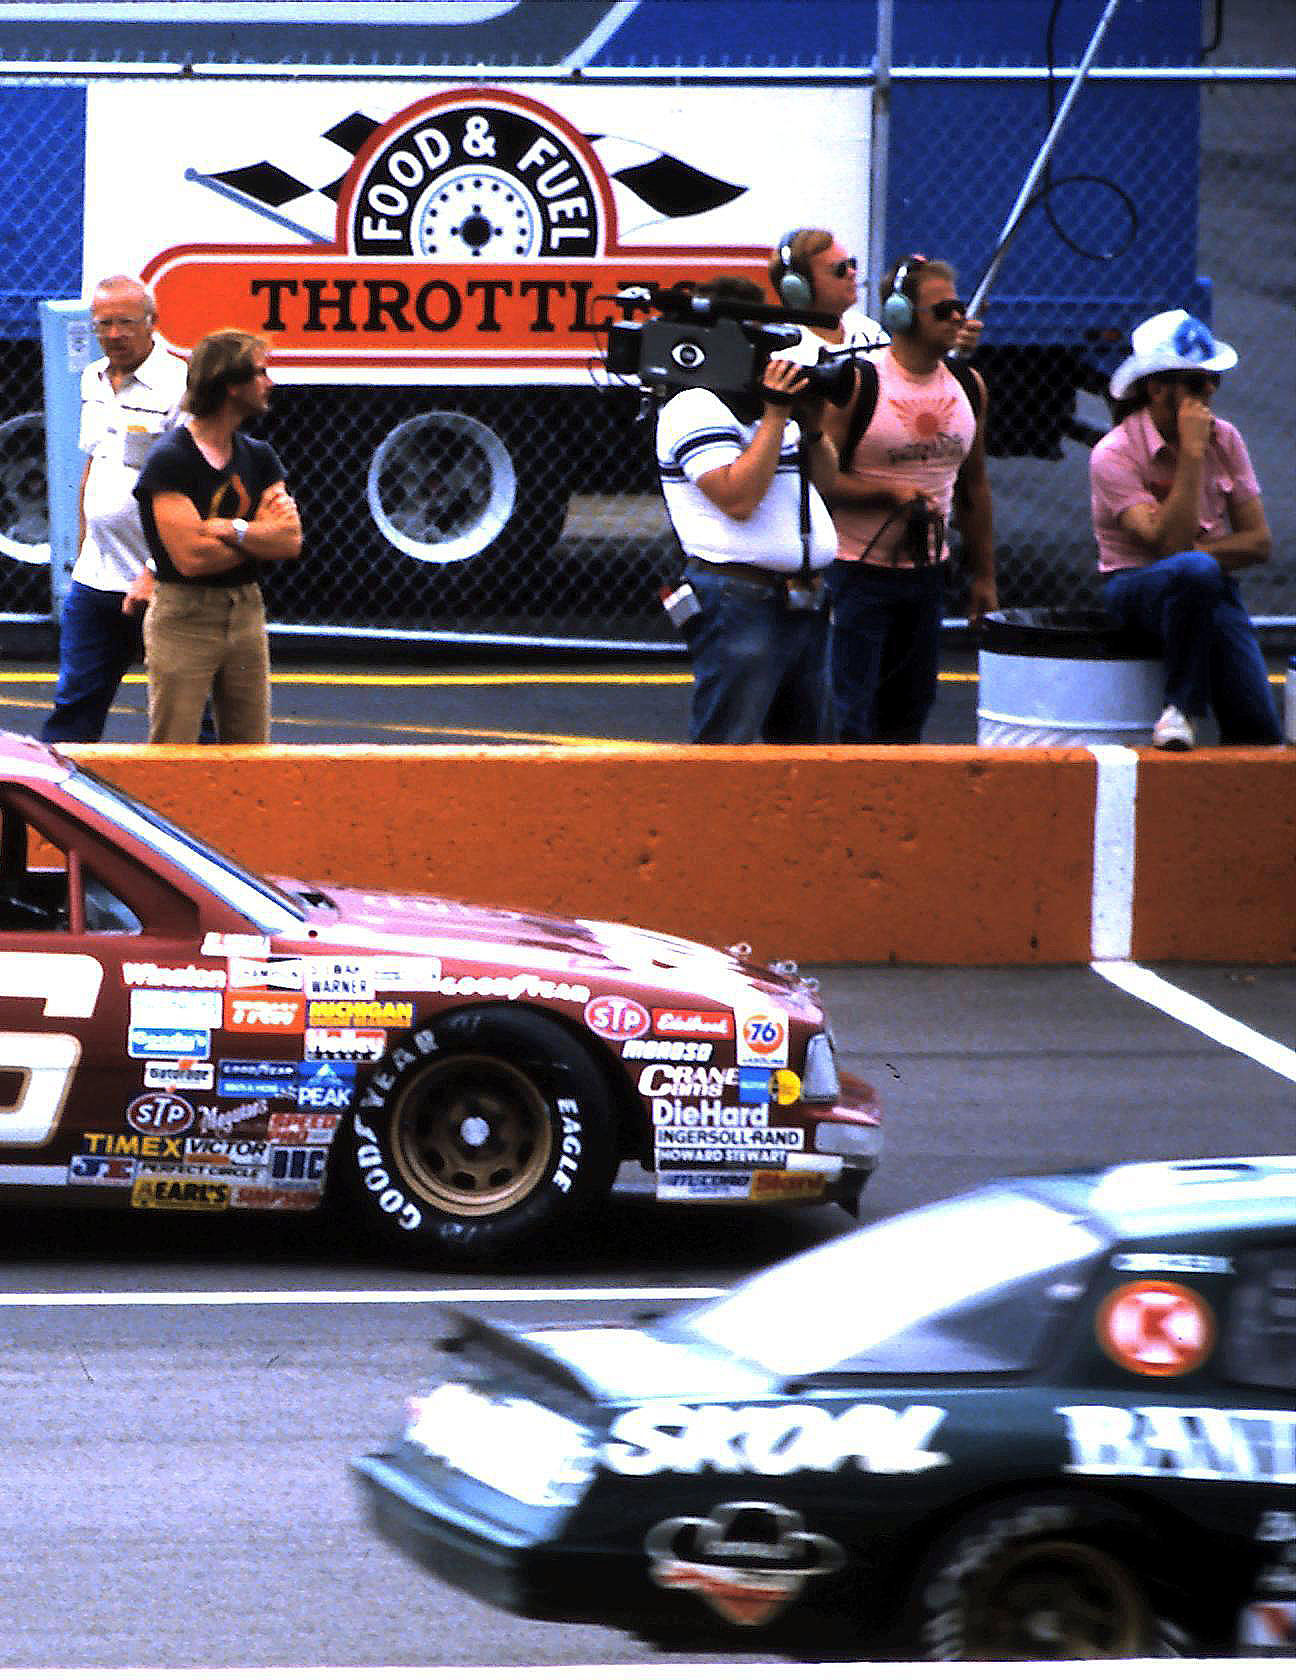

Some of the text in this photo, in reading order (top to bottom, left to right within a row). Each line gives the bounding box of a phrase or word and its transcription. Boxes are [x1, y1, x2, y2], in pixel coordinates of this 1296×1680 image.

[362, 115, 592, 250] FOOD & FUEL
[593, 1001, 642, 1032] STP
[750, 1022, 777, 1044] 76
[298, 1086, 353, 1107] PEAK
[137, 1098, 186, 1127] STP
[653, 1098, 769, 1127] DieHard
[83, 1133, 183, 1157] TIMEX
[553, 1098, 583, 1193] EAGLE
[600, 1402, 951, 1475] SKOAL
